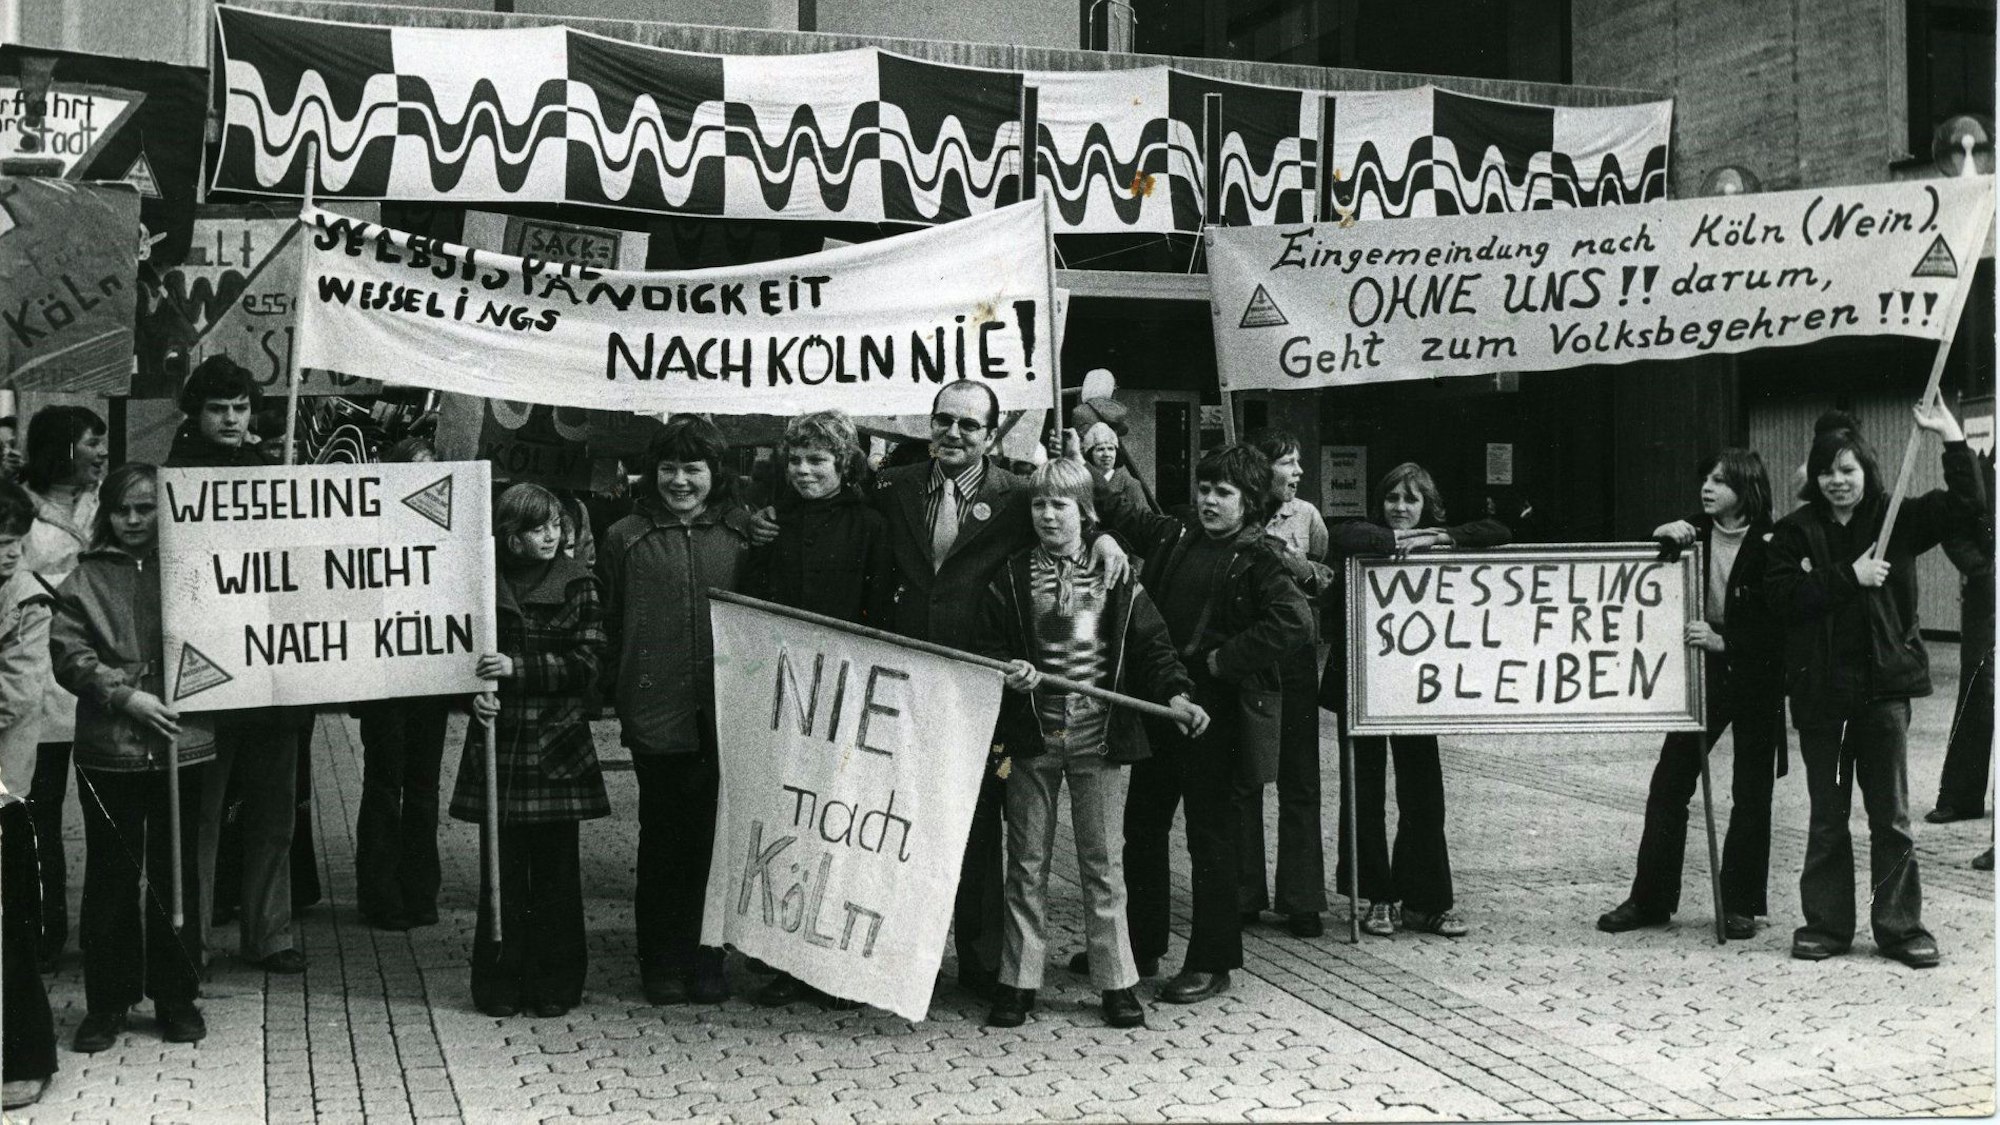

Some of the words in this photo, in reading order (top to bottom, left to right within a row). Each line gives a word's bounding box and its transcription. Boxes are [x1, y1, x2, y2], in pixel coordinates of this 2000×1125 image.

[1270, 227, 1549, 274] Eingemeindung
[1571, 223, 1656, 257] nach
[1690, 212, 1785, 248] Köln
[1349, 272, 1482, 328] OHNE
[1672, 262, 1833, 297] darum,
[606, 332, 752, 388] NACH
[767, 333, 895, 387] KÖLN
[1279, 330, 1385, 379] Geht
[1421, 335, 1518, 362] zum
[1549, 302, 1859, 355] Volksbegehren
[166, 476, 382, 523] WESSELING
[213, 550, 299, 595] WILL
[325, 545, 437, 590] NICHT
[1367, 560, 1666, 609] WESSELING
[245, 619, 348, 667] NACH
[374, 610, 474, 659] KÖLN
[1375, 609, 1503, 657] SOLL
[1533, 604, 1644, 646] FREI
[770, 645, 910, 759] NIE
[1416, 647, 1668, 705] BLEIBEN
[783, 784, 912, 863] nach
